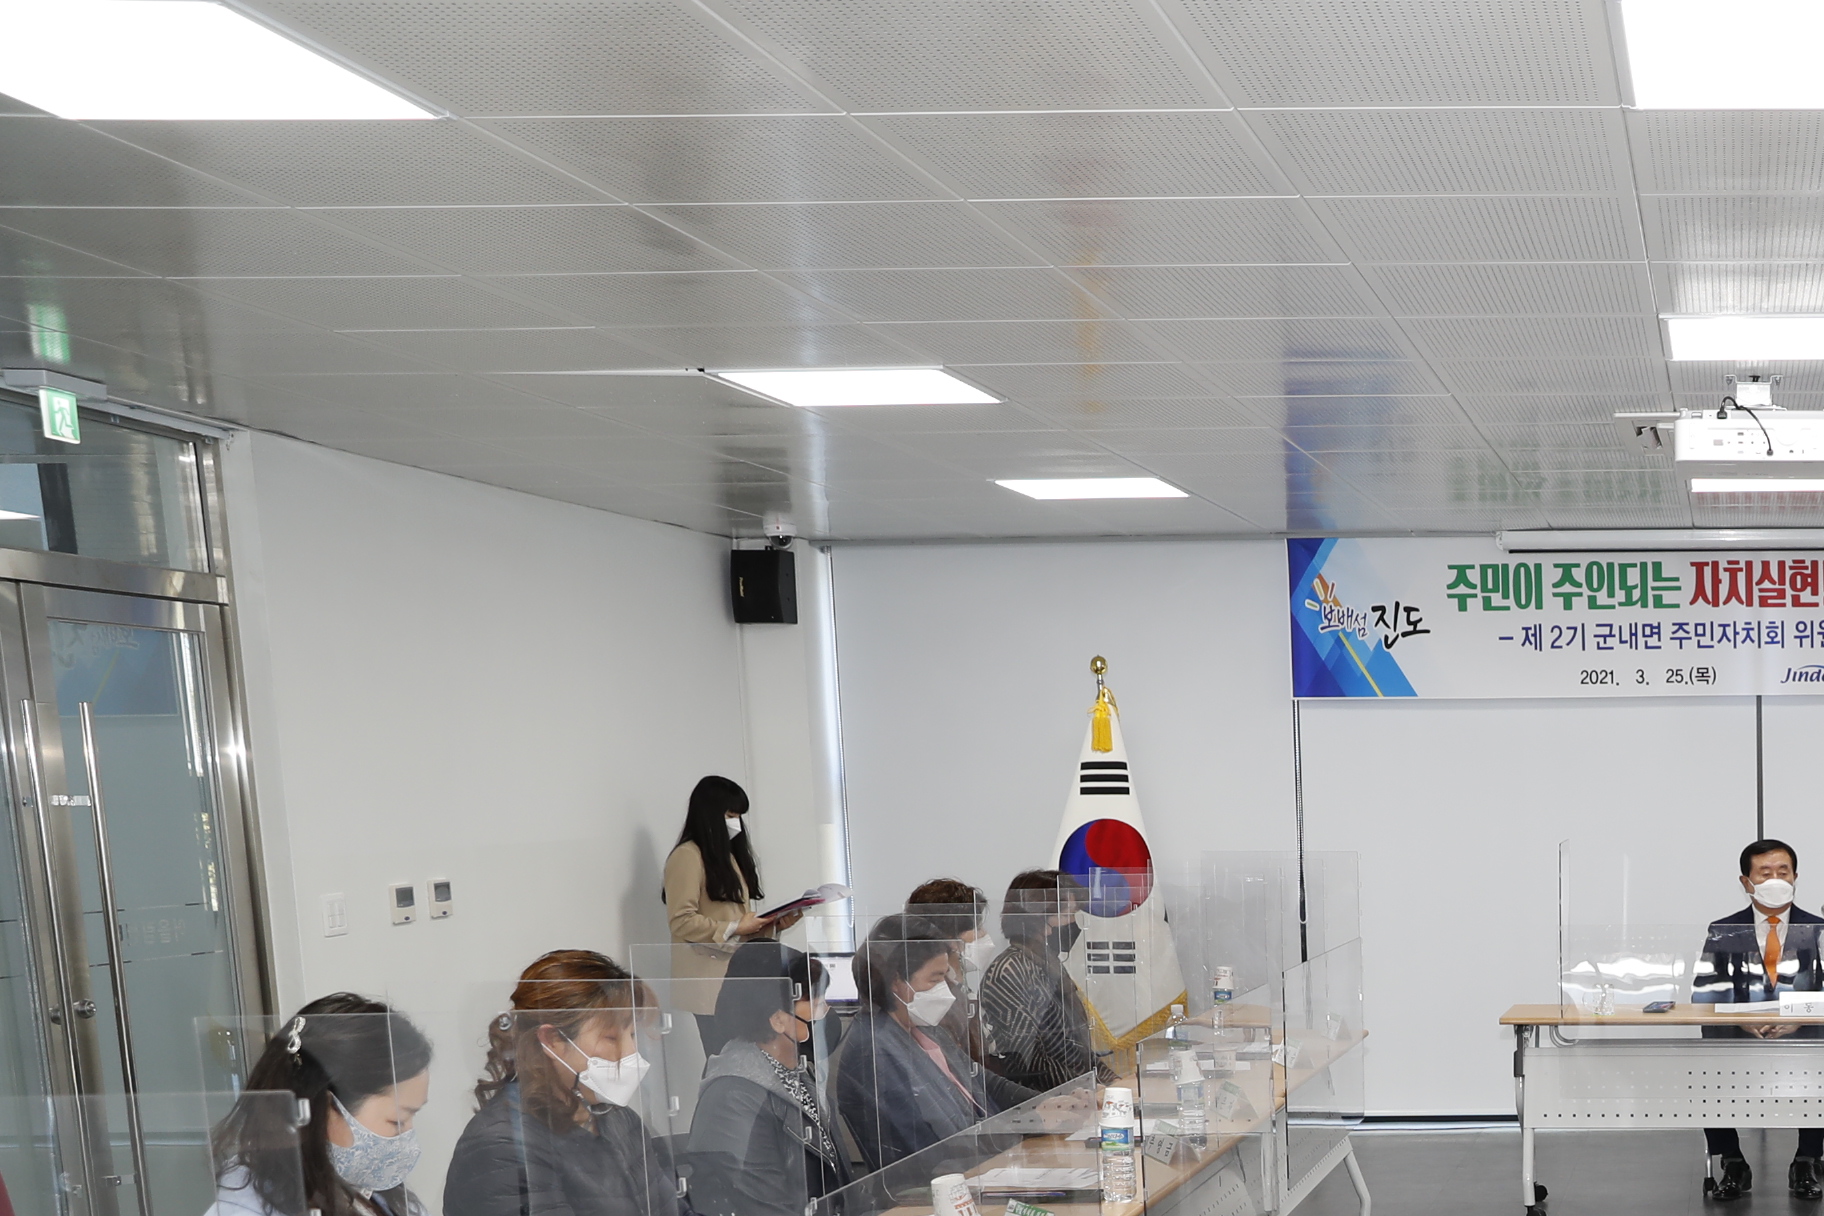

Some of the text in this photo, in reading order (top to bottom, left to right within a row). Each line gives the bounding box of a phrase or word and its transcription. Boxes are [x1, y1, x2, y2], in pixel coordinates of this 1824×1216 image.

[1446, 562, 1543, 612] 주민이
[1551, 561, 1682, 611] 주인되는
[1319, 601, 1431, 650] 보배섬 진도
[1550, 622, 1586, 651] 2기
[1593, 621, 1663, 650] 군내면
[1669, 620, 1785, 650] 주민자치회
[1580, 666, 1717, 686] 2021. 3. 25.(목)
